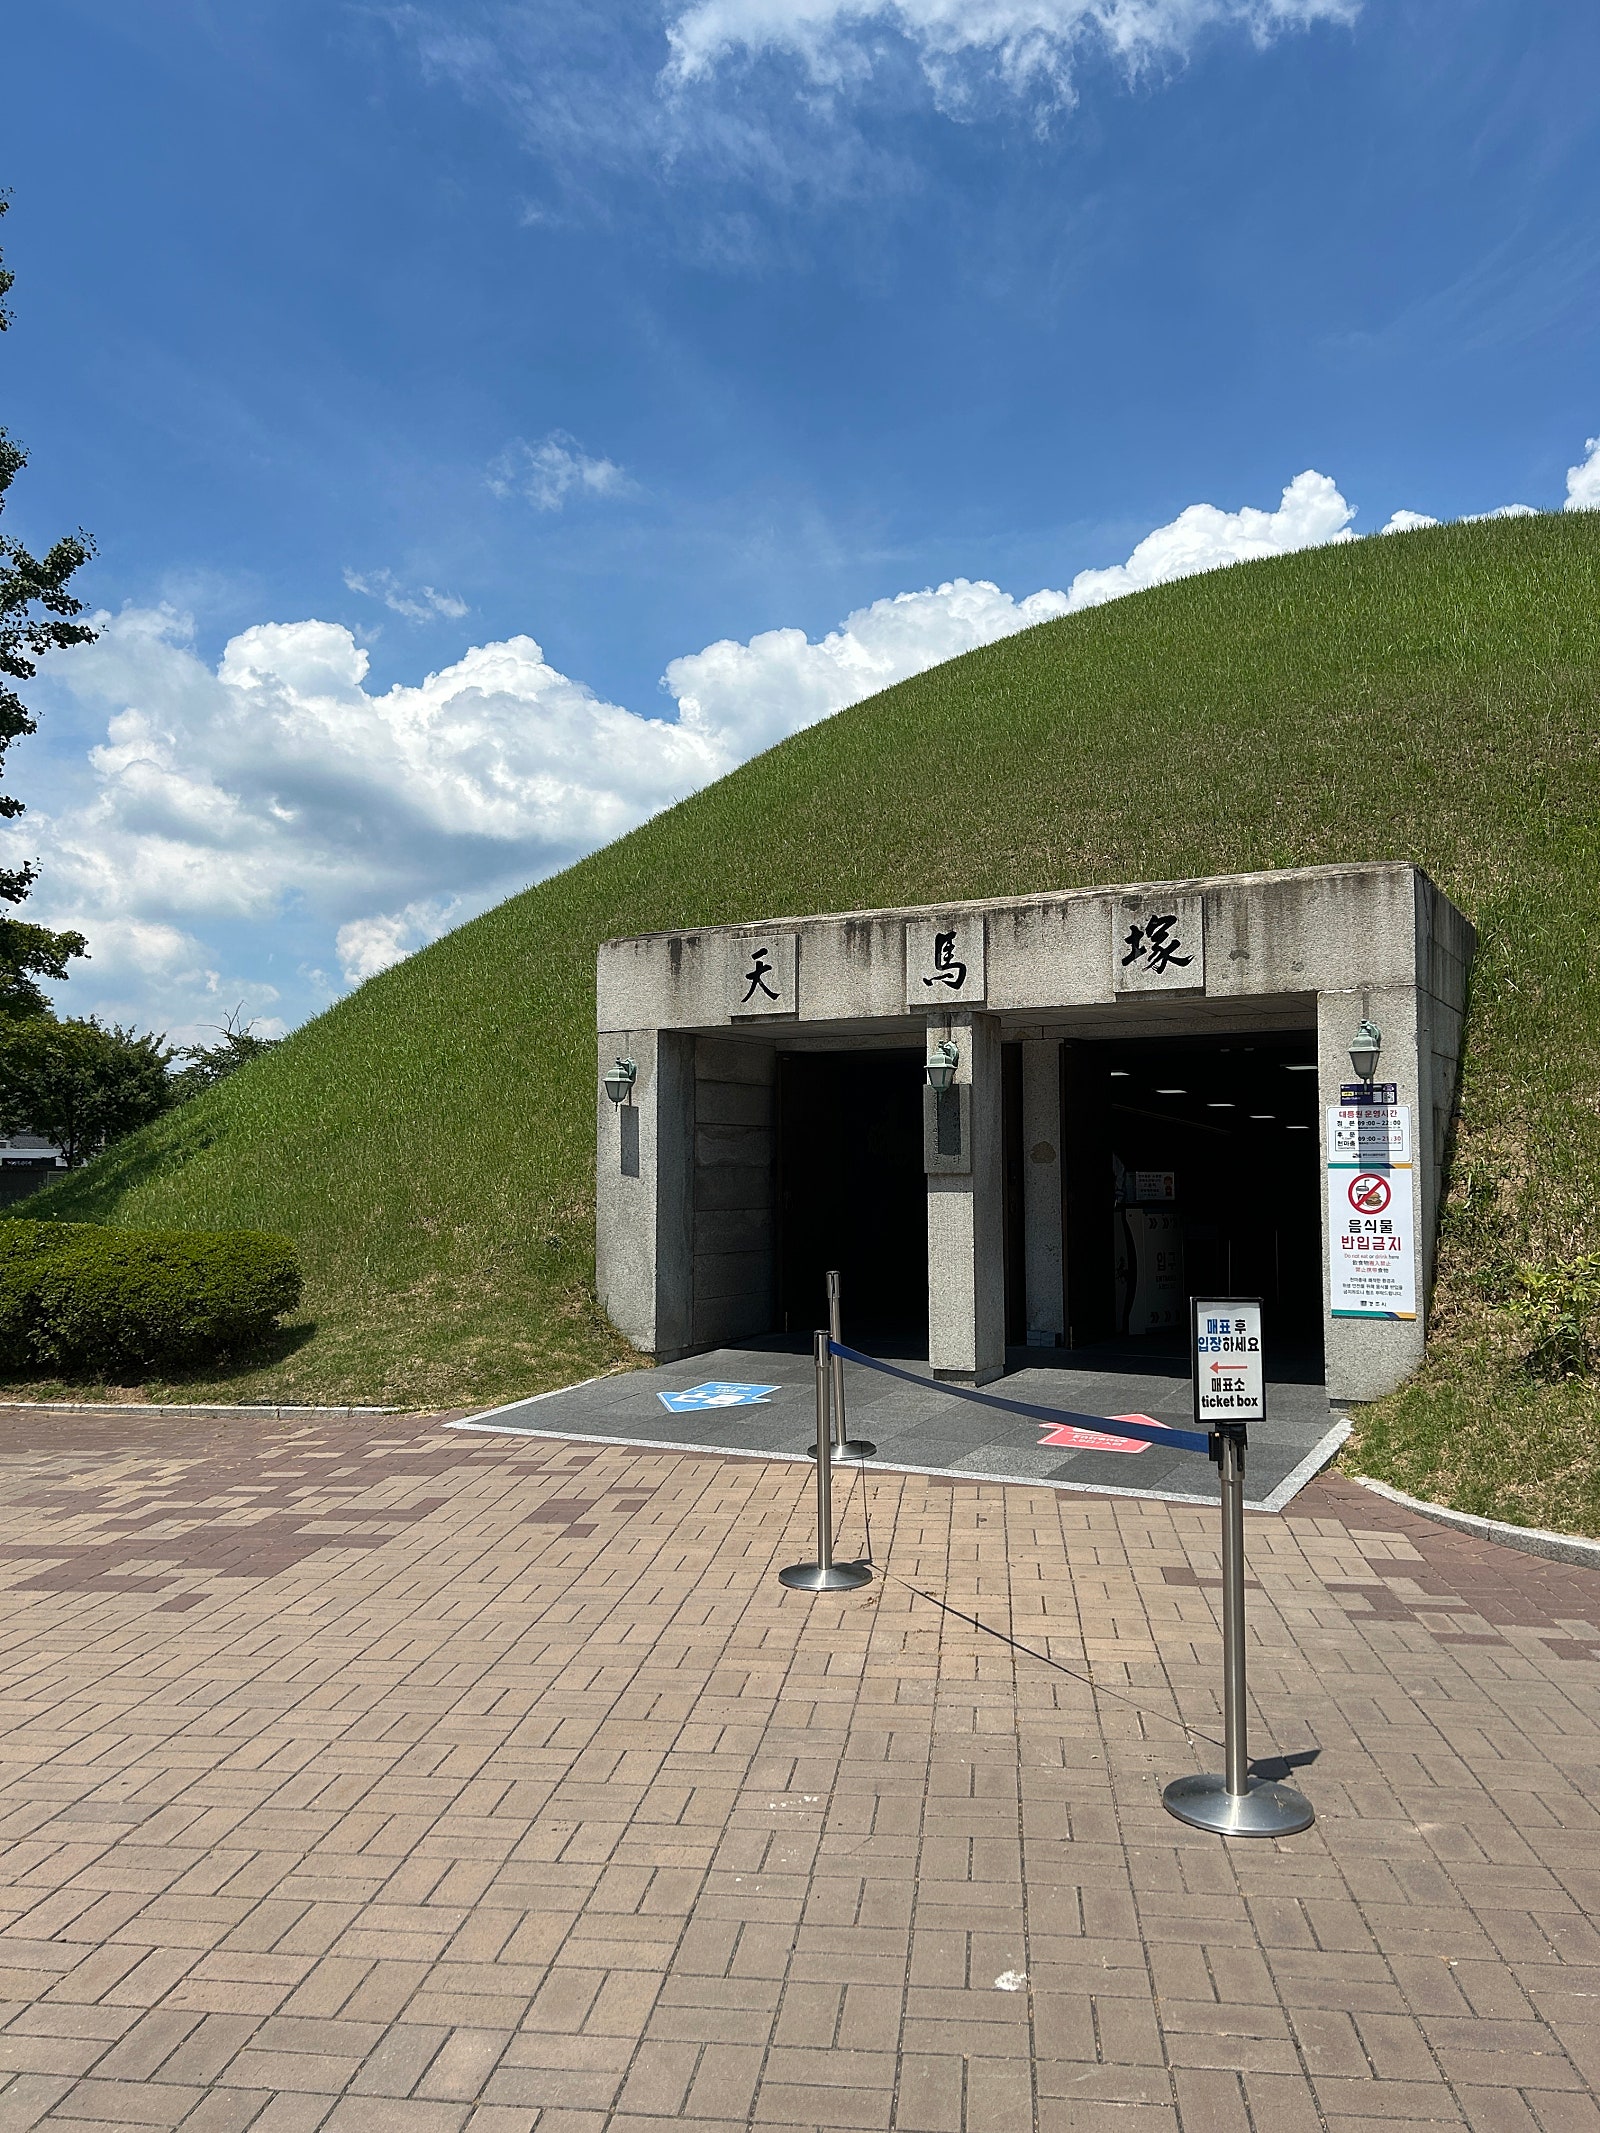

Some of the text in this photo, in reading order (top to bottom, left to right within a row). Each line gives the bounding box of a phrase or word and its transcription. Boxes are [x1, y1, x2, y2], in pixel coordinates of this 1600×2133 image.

[1338, 1110, 1398, 1118] 대릉원 운영시간
[1348, 1219, 1393, 1234] 음식물
[1341, 1235, 1402, 1251] 반입금지
[1206, 1318, 1247, 1335] 매표 후
[1198, 1336, 1260, 1353] 입장하세요
[1211, 1377, 1246, 1392] 매표소
[1201, 1394, 1259, 1408] ticket box
[1072, 1434, 1129, 1443] Entrance
